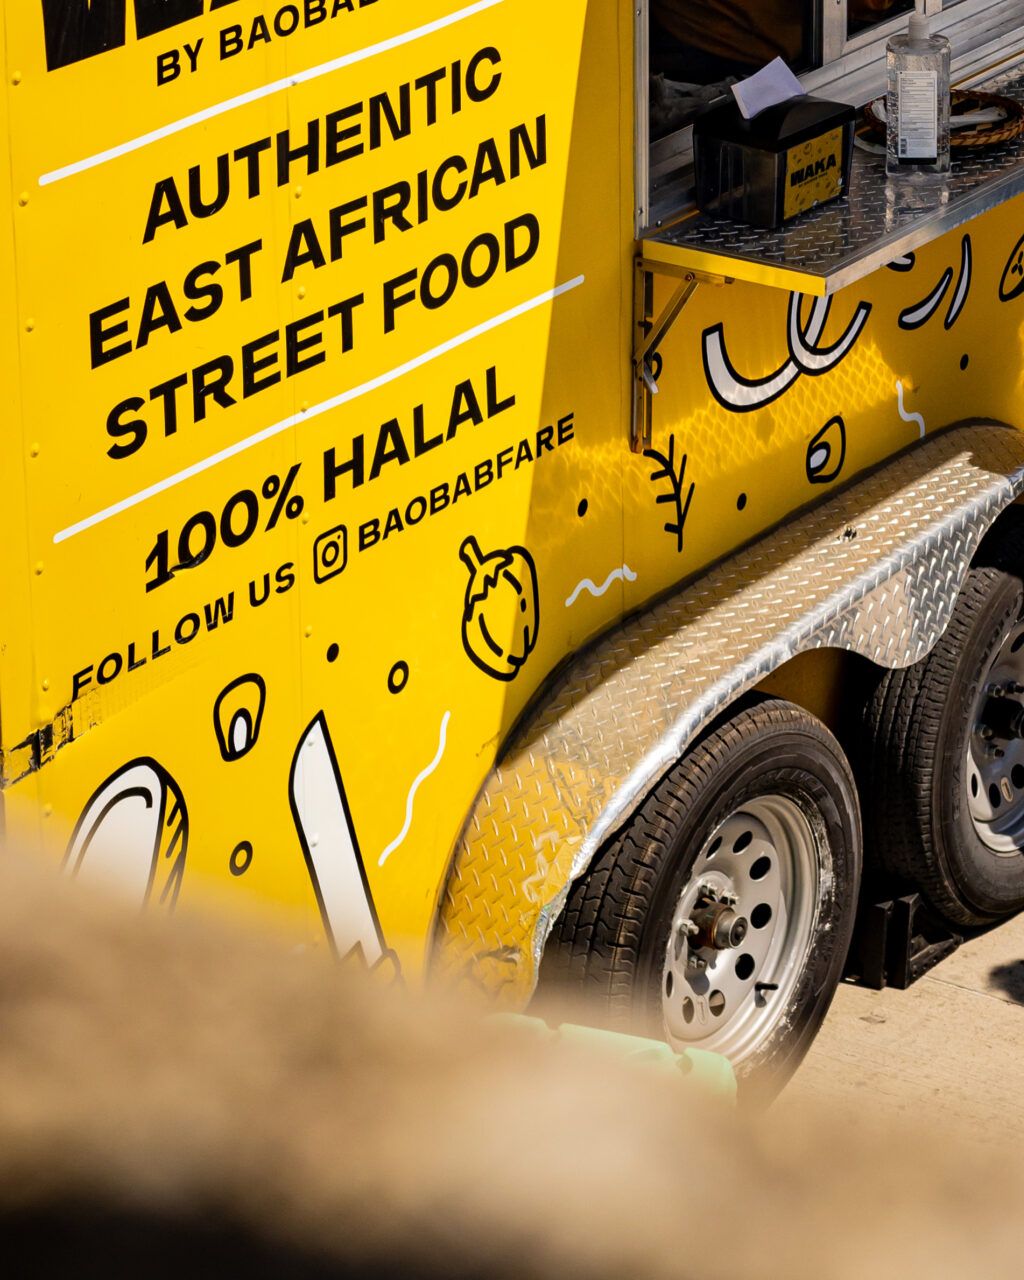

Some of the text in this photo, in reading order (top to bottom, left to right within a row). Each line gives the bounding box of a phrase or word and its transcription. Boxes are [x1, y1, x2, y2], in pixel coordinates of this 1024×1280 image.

[142, 46, 502, 245] AUTHENTIC
[156, 38, 204, 87] BY
[790, 153, 837, 187] WAKA
[89, 114, 547, 370] EAST AFRICAN
[106, 213, 540, 460] STREET FOOD
[71, 412, 575, 703] FOLLOW US BAOBABFARE
[145, 366, 516, 593] 100% HALAL
